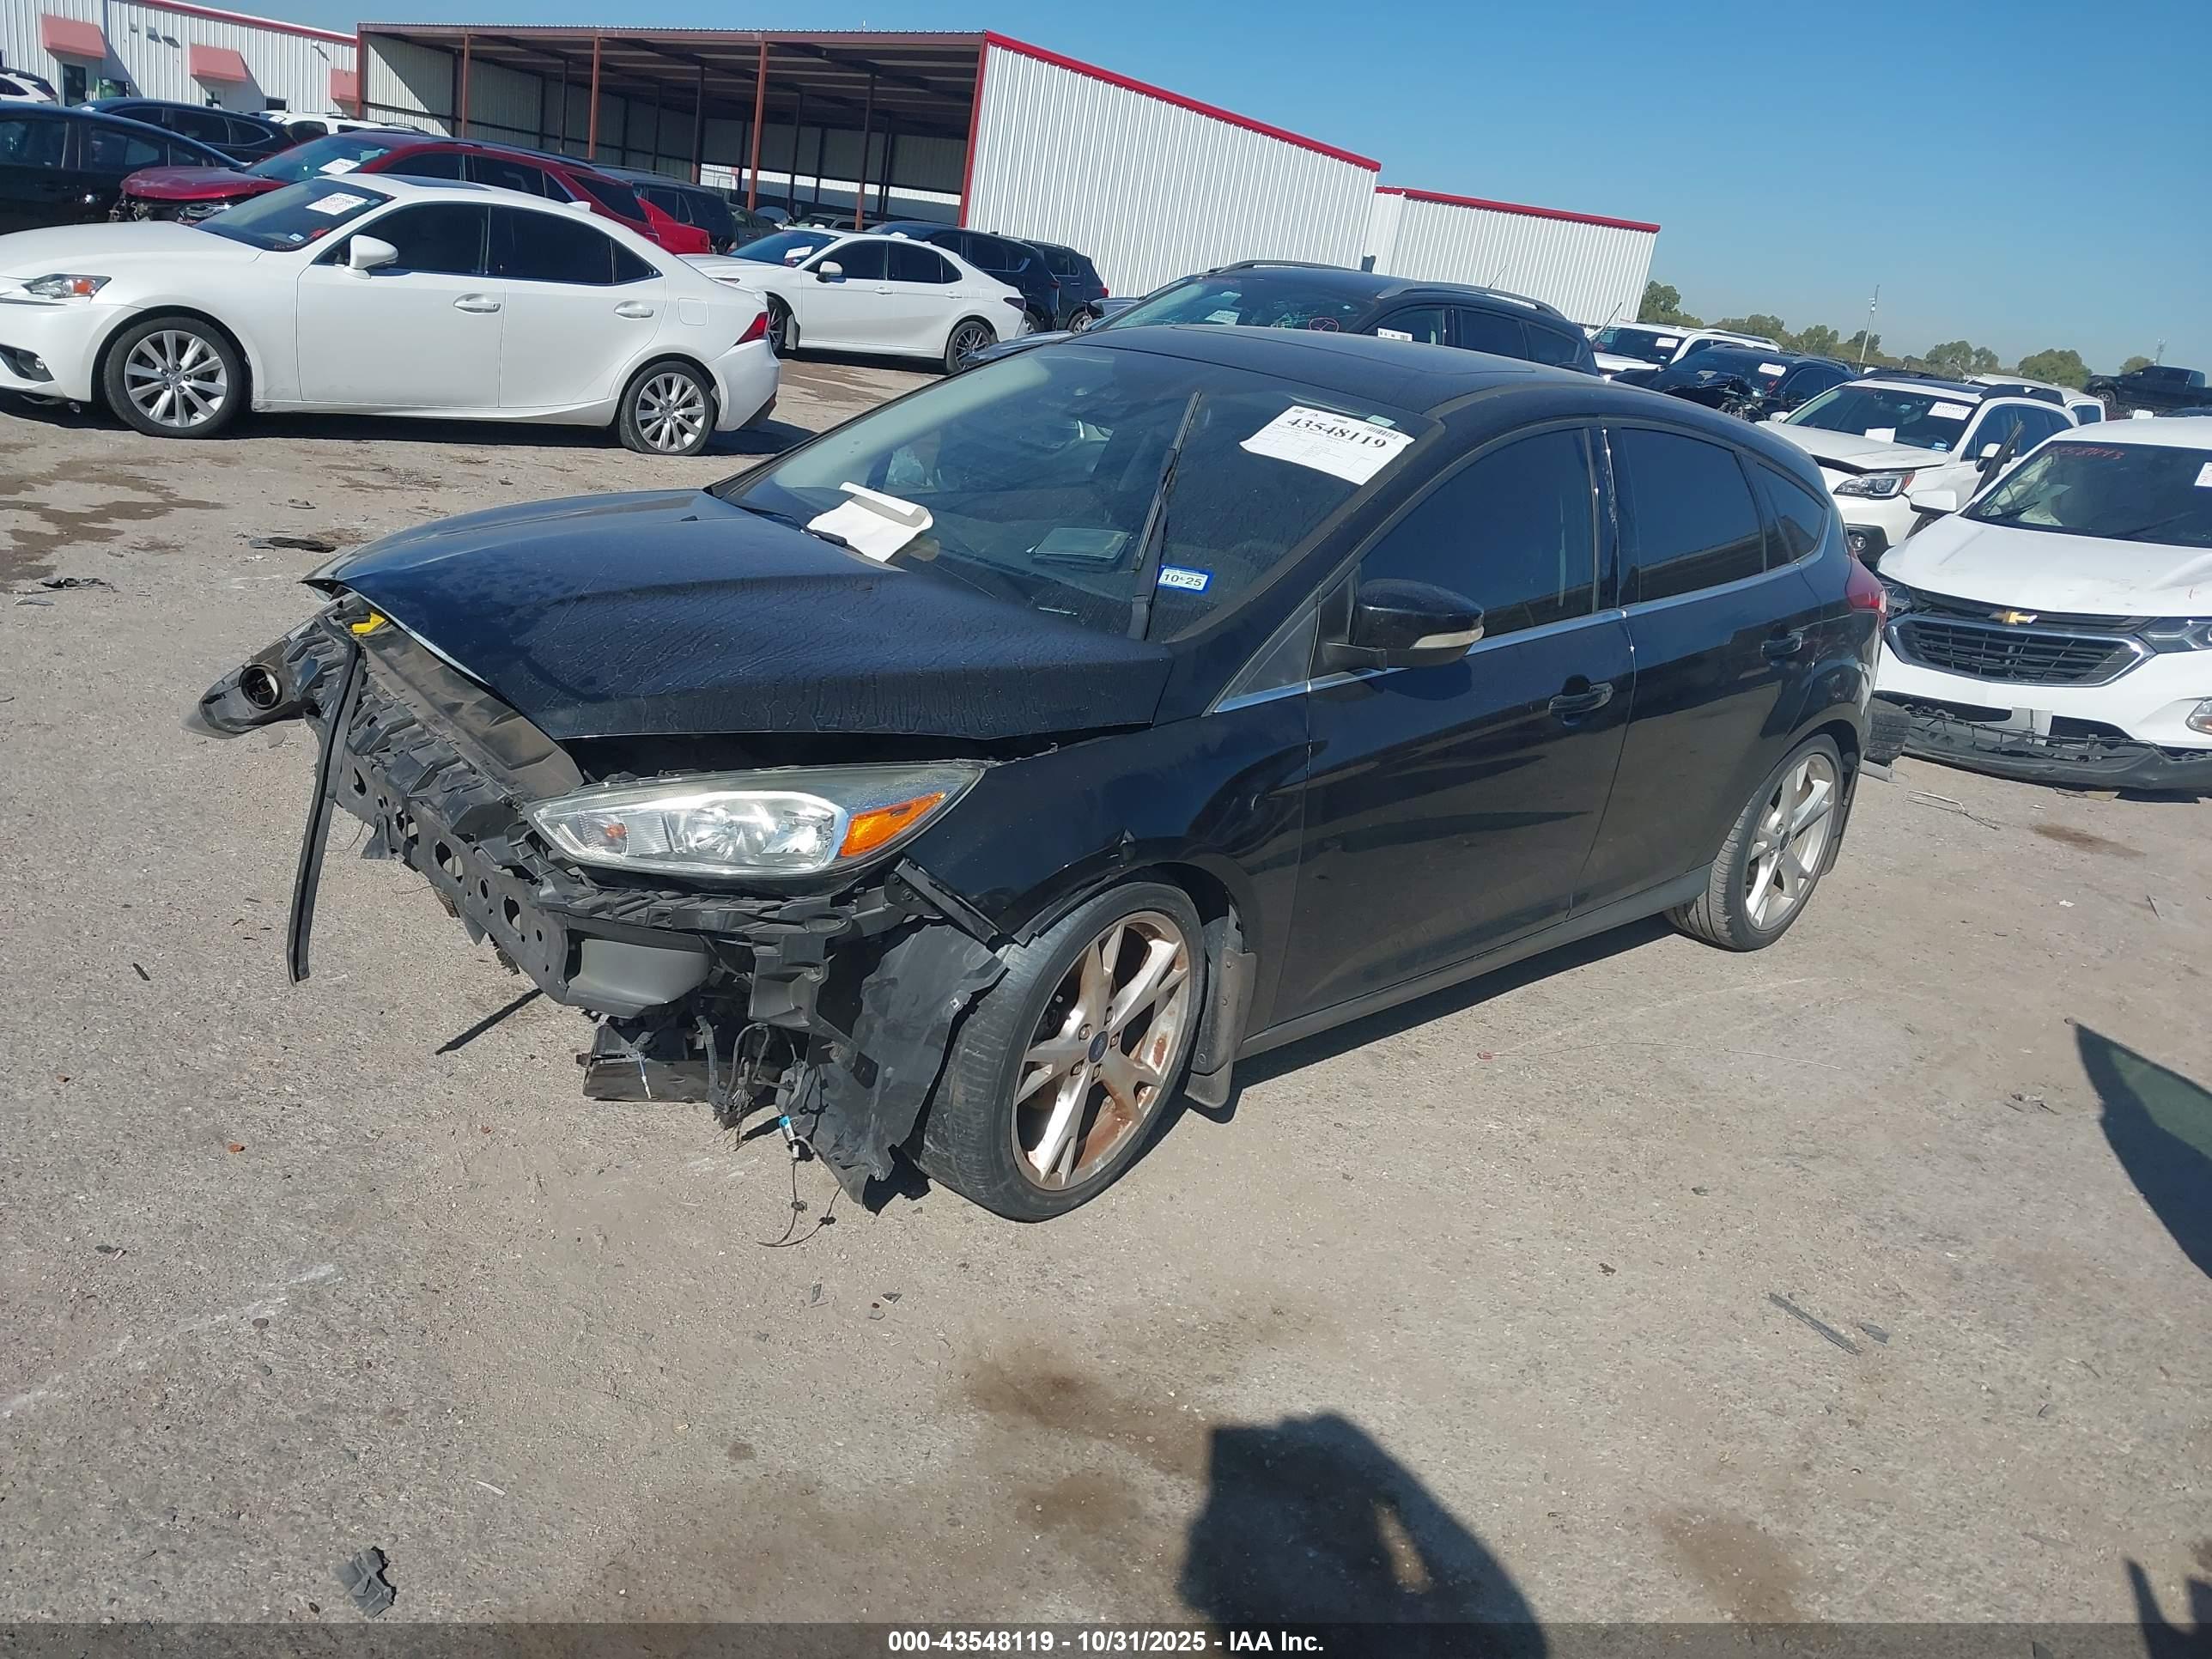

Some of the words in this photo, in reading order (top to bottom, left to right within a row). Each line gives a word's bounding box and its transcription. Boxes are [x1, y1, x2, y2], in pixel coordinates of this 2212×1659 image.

[1286, 418, 1387, 448] 43548119
[1164, 574, 1180, 583] 10
[1185, 576, 1203, 586] 25
